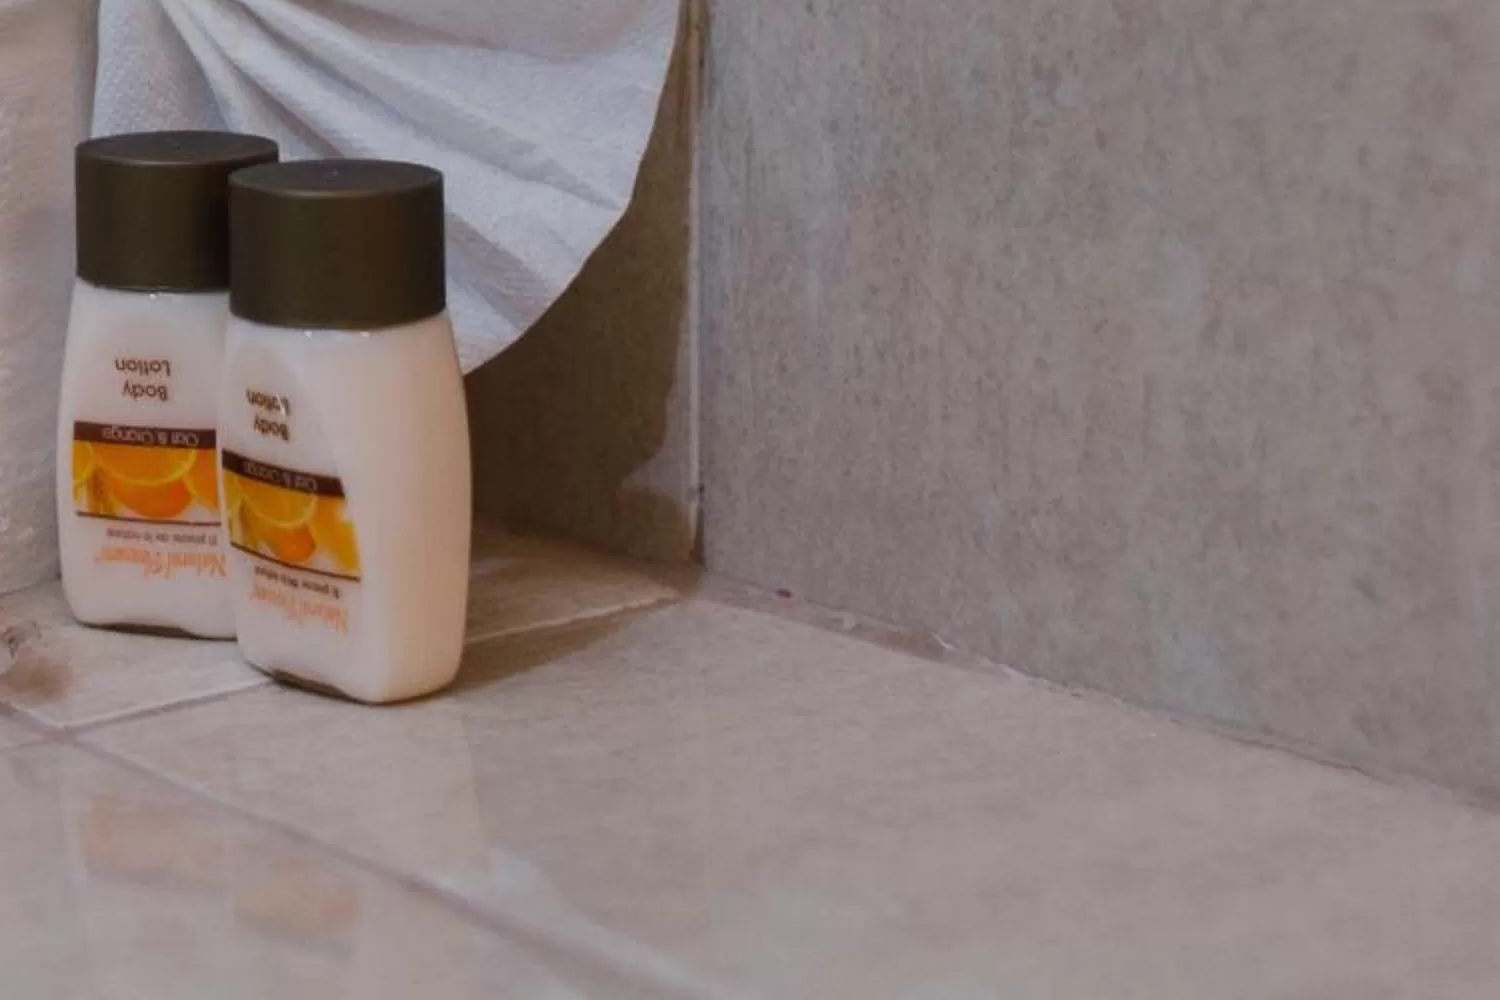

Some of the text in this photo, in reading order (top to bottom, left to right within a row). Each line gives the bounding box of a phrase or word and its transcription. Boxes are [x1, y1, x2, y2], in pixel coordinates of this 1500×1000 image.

[115, 358, 171, 377] Lotion
[122, 380, 169, 401] Body
[246, 389, 291, 416] Lotion
[102, 426, 155, 444] Orange
[254, 415, 289, 441] Body
[171, 432, 200, 446] Oat
